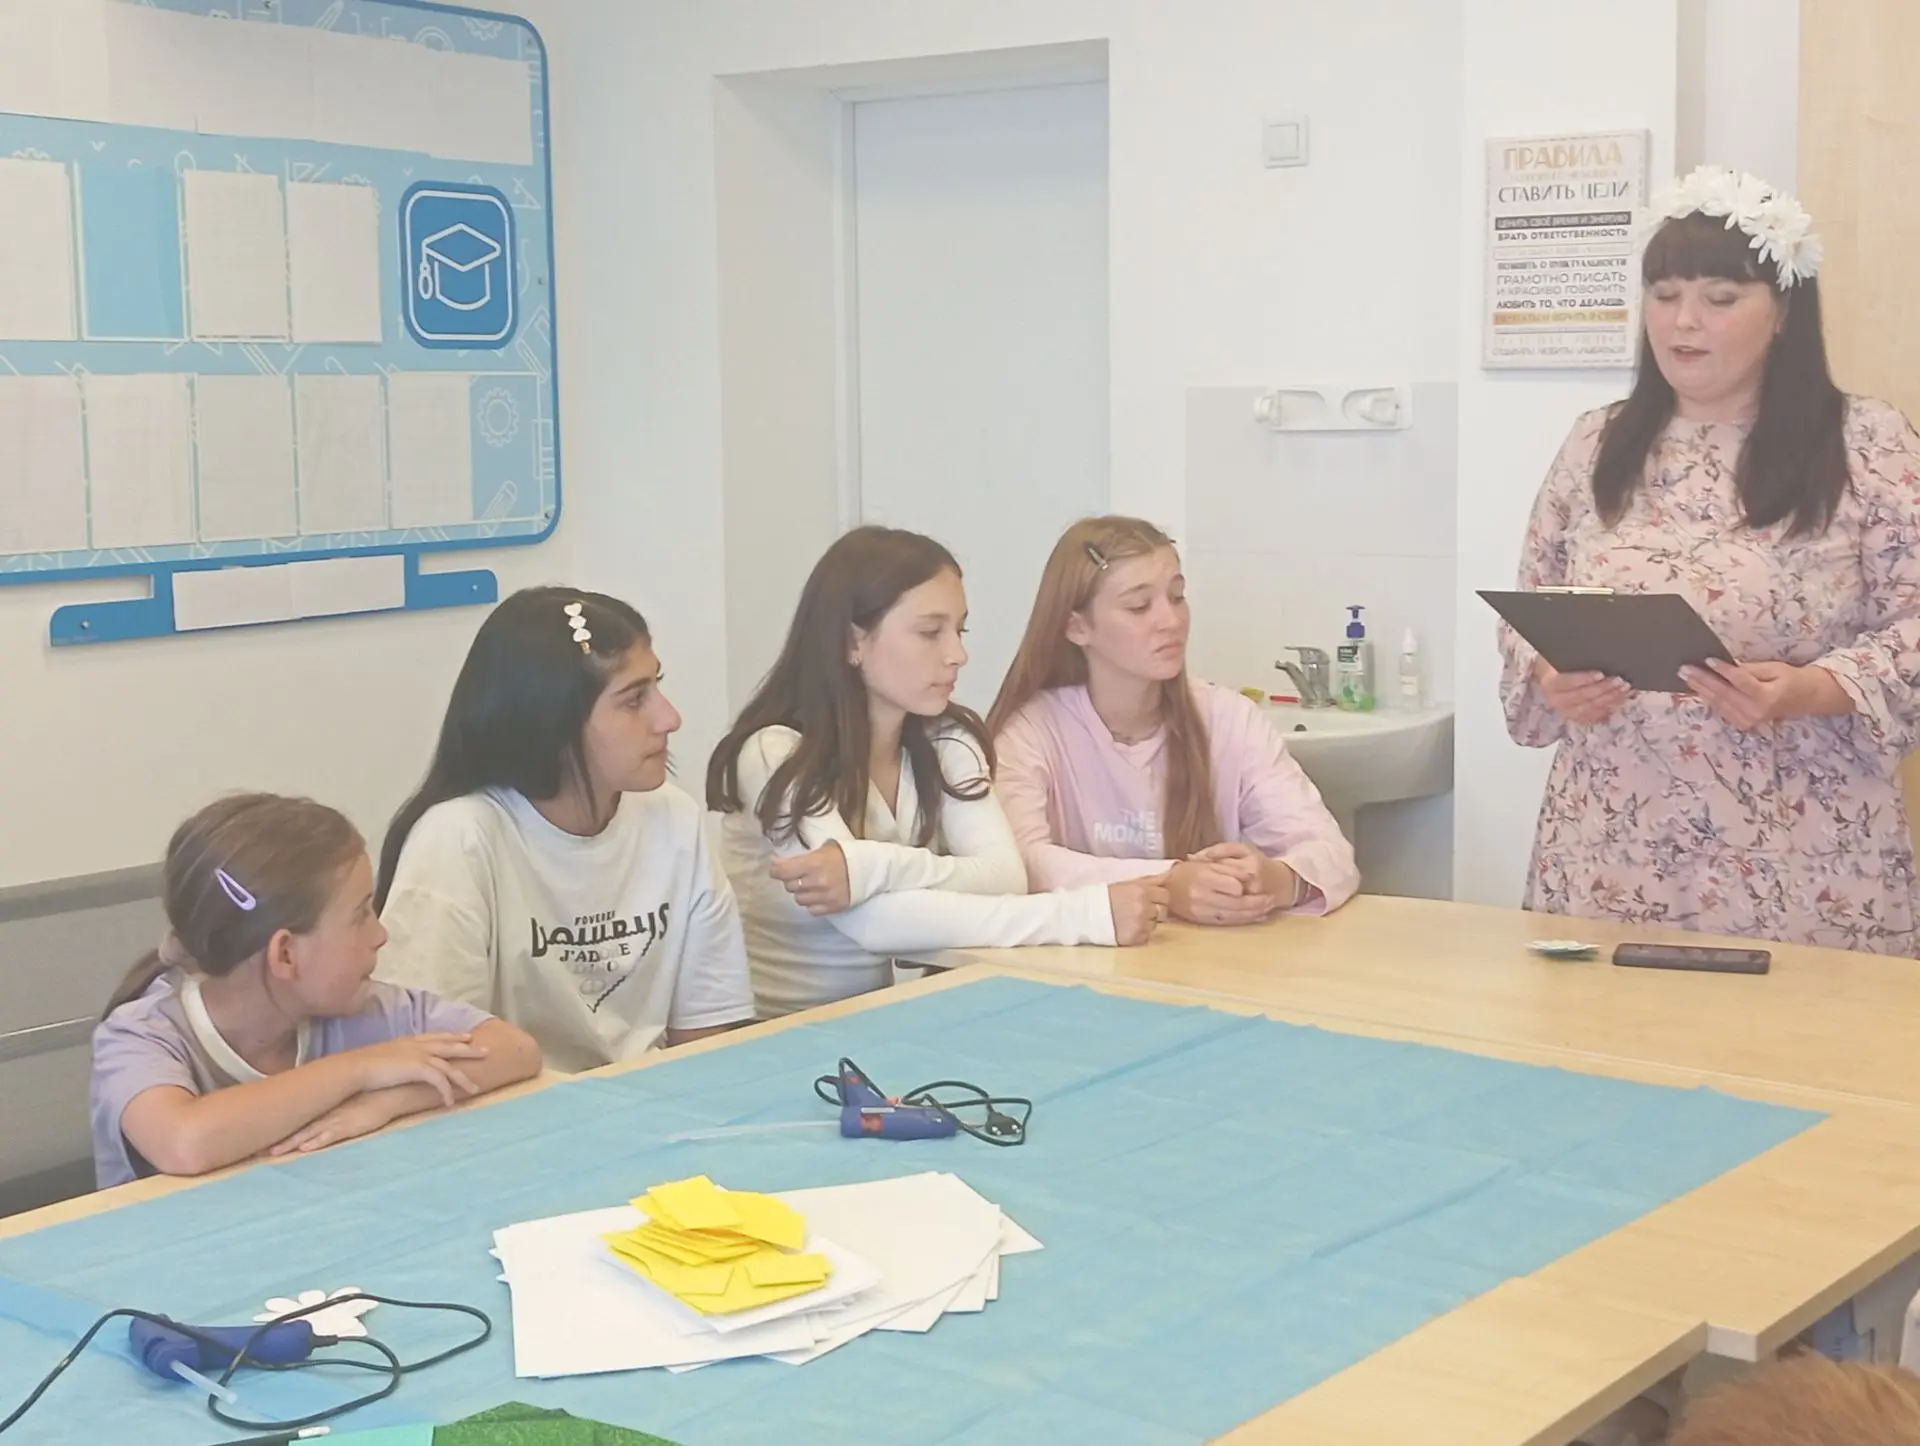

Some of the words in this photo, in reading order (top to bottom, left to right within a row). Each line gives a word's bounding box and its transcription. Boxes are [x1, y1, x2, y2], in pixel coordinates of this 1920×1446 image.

[1503, 141, 1623, 170] ПРАВИЛА
[1498, 184, 1575, 203] СТАВИТЬ
[1581, 181, 1630, 200] ЦЕЛИ
[1497, 232, 1527, 242] БРАТЬ
[1530, 228, 1628, 240] ОТВЕТСТВЕННОСТЬ
[1497, 273, 1569, 285] ГРАМОТНО
[1572, 271, 1627, 283] ПИСАТЬ
[1509, 285, 1562, 296] КРАСИВО
[1565, 283, 1626, 294] ГОВОРИТЬ
[1496, 299, 1537, 309] ЛЮБИТЬ
[1557, 299, 1577, 308] ЧТО
[1579, 297, 1626, 308] ДЕЛАЕШЬ
